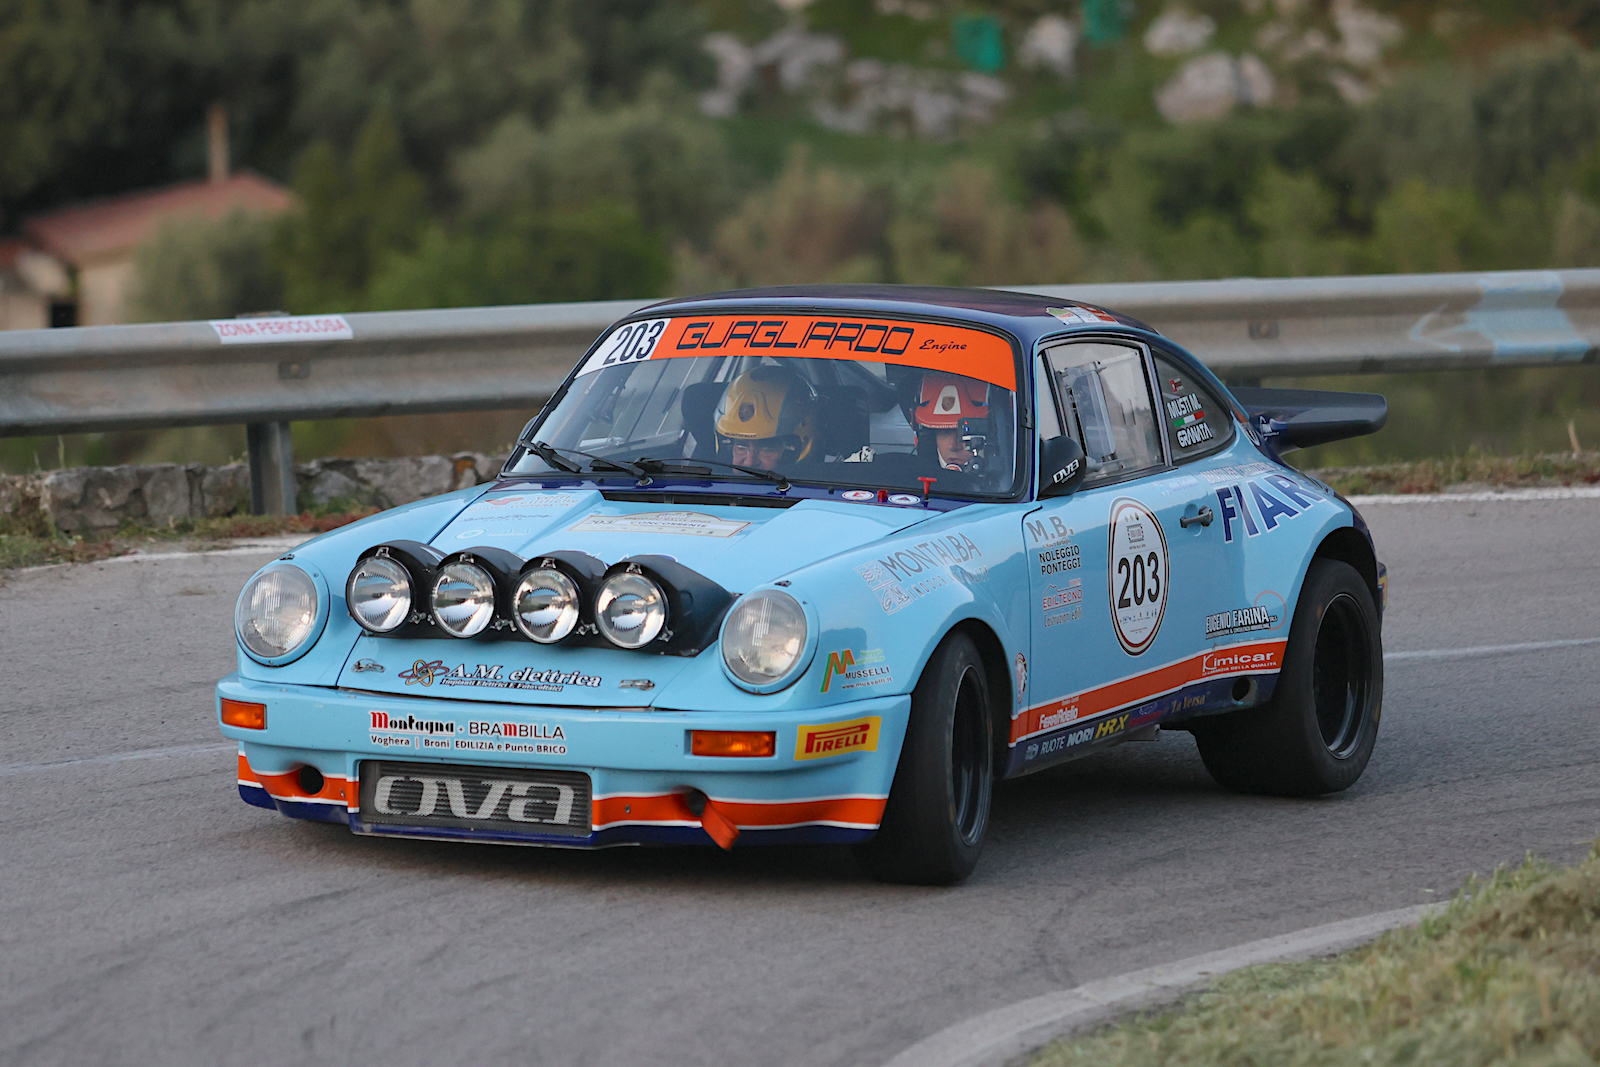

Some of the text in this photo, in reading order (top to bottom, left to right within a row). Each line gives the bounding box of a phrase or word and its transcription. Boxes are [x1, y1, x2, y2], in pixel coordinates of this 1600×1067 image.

[216, 319, 347, 337] ZONA PERICOLOSA
[676, 320, 967, 355] GUAGLIARDO Engine
[603, 320, 663, 364] 203
[1166, 395, 1192, 420] MUSTI
[1177, 422, 1213, 448] GRANATA
[1215, 474, 1327, 545] FIAR
[1025, 515, 1075, 543] M.B.
[877, 531, 982, 582] MONTALBA
[1039, 545, 1080, 564] NOLEGGIO
[1041, 557, 1081, 576] PONTEGGI
[1117, 551, 1160, 609] 203
[1043, 589, 1083, 608] EDILTECNO
[1205, 610, 1231, 634] EUGENIO
[1232, 605, 1269, 628] FARINA
[445, 664, 602, 687] A.M. elettrica
[845, 666, 890, 680] MUSSELLI
[1202, 653, 1275, 673] Kimicar
[440, 678, 475, 686] Impianti
[476, 680, 509, 688] Elettrici
[516, 683, 563, 692] Fotovoltaici
[842, 677, 892, 689] www.musselli.it
[371, 735, 410, 747] Voghera
[424, 739, 450, 748] Broni
[455, 740, 494, 750] EDILIZIA
[505, 743, 534, 753] Punto
[536, 745, 566, 754] BRICO
[805, 723, 870, 754] PIRELLI
[1040, 736, 1066, 756] RUOTE
[1067, 727, 1095, 748] NORI
[1095, 714, 1130, 739] HRX
